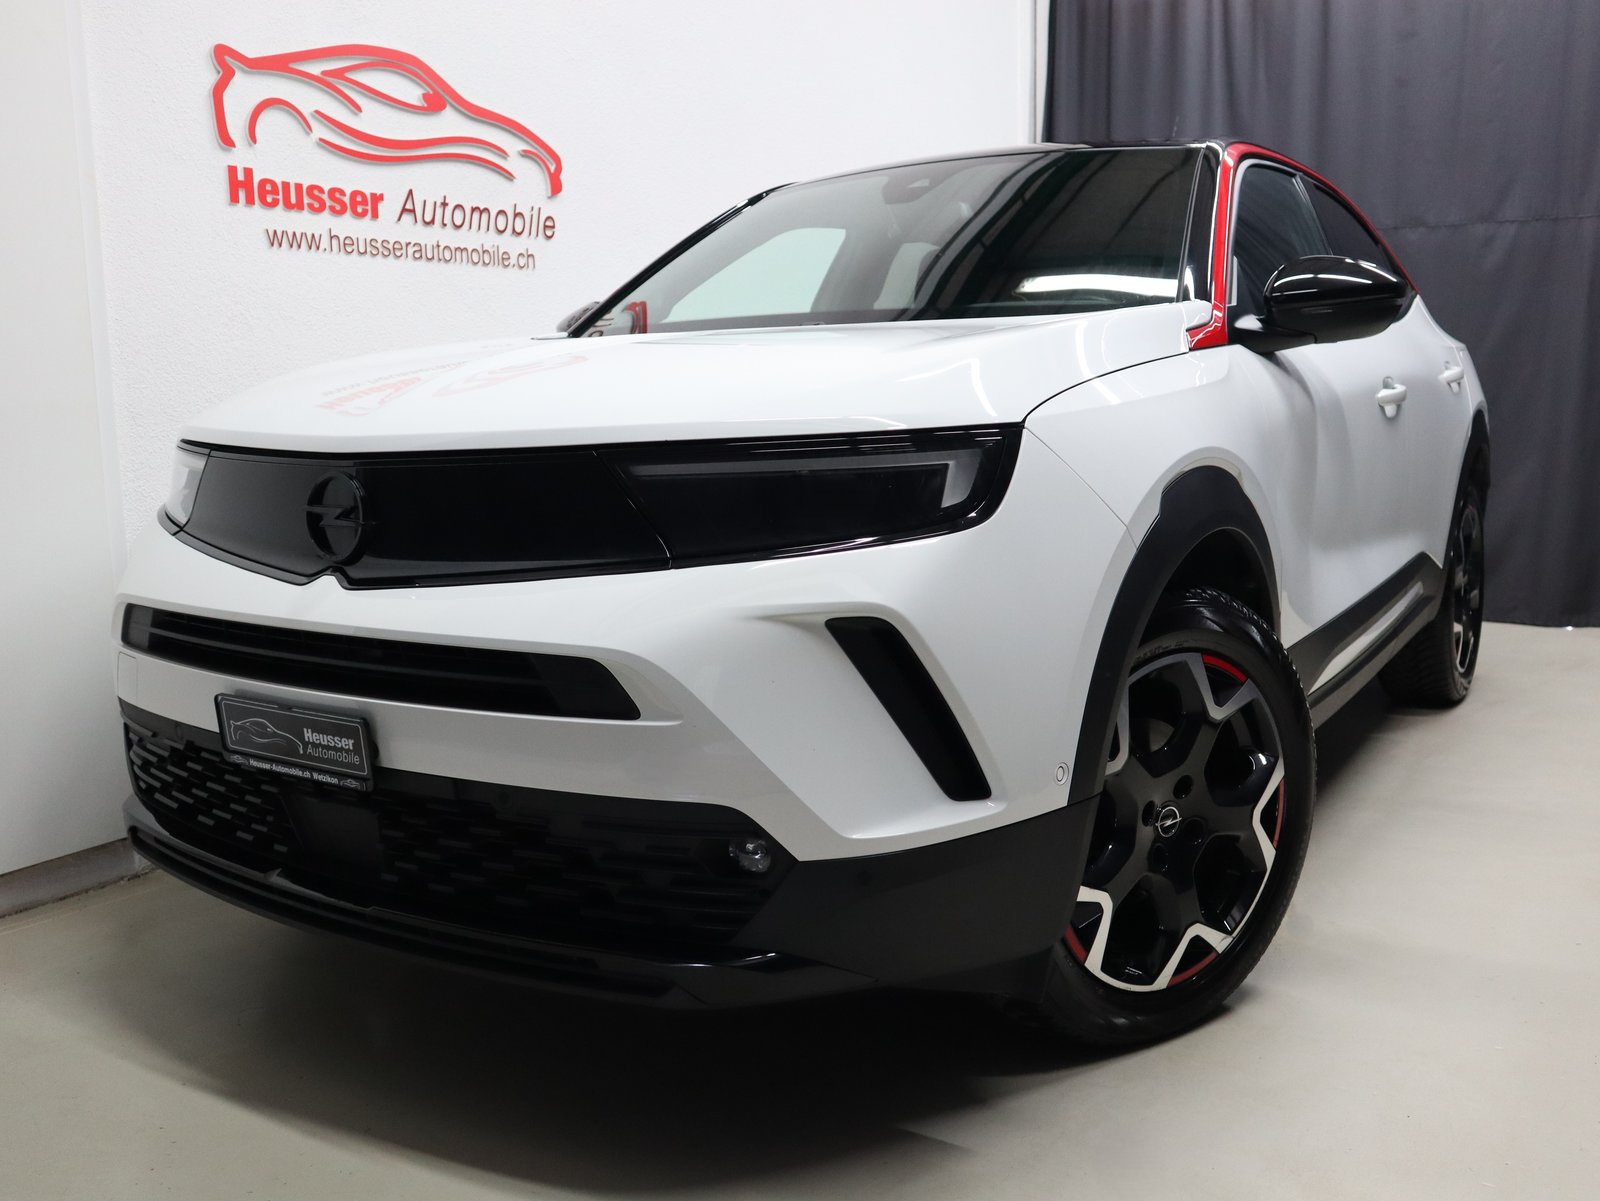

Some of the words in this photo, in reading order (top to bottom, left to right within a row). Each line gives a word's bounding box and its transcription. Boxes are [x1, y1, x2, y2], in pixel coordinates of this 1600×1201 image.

[227, 165, 384, 219] Heusser
[397, 188, 556, 239] Automobile
[266, 228, 536, 270] www.heusserautomobile.ch
[303, 728, 355, 750] Heusser
[307, 745, 360, 765] Automobile
[250, 758, 311, 779] Heusser-Automobile.ch
[313, 772, 339, 784] Wetzikon
